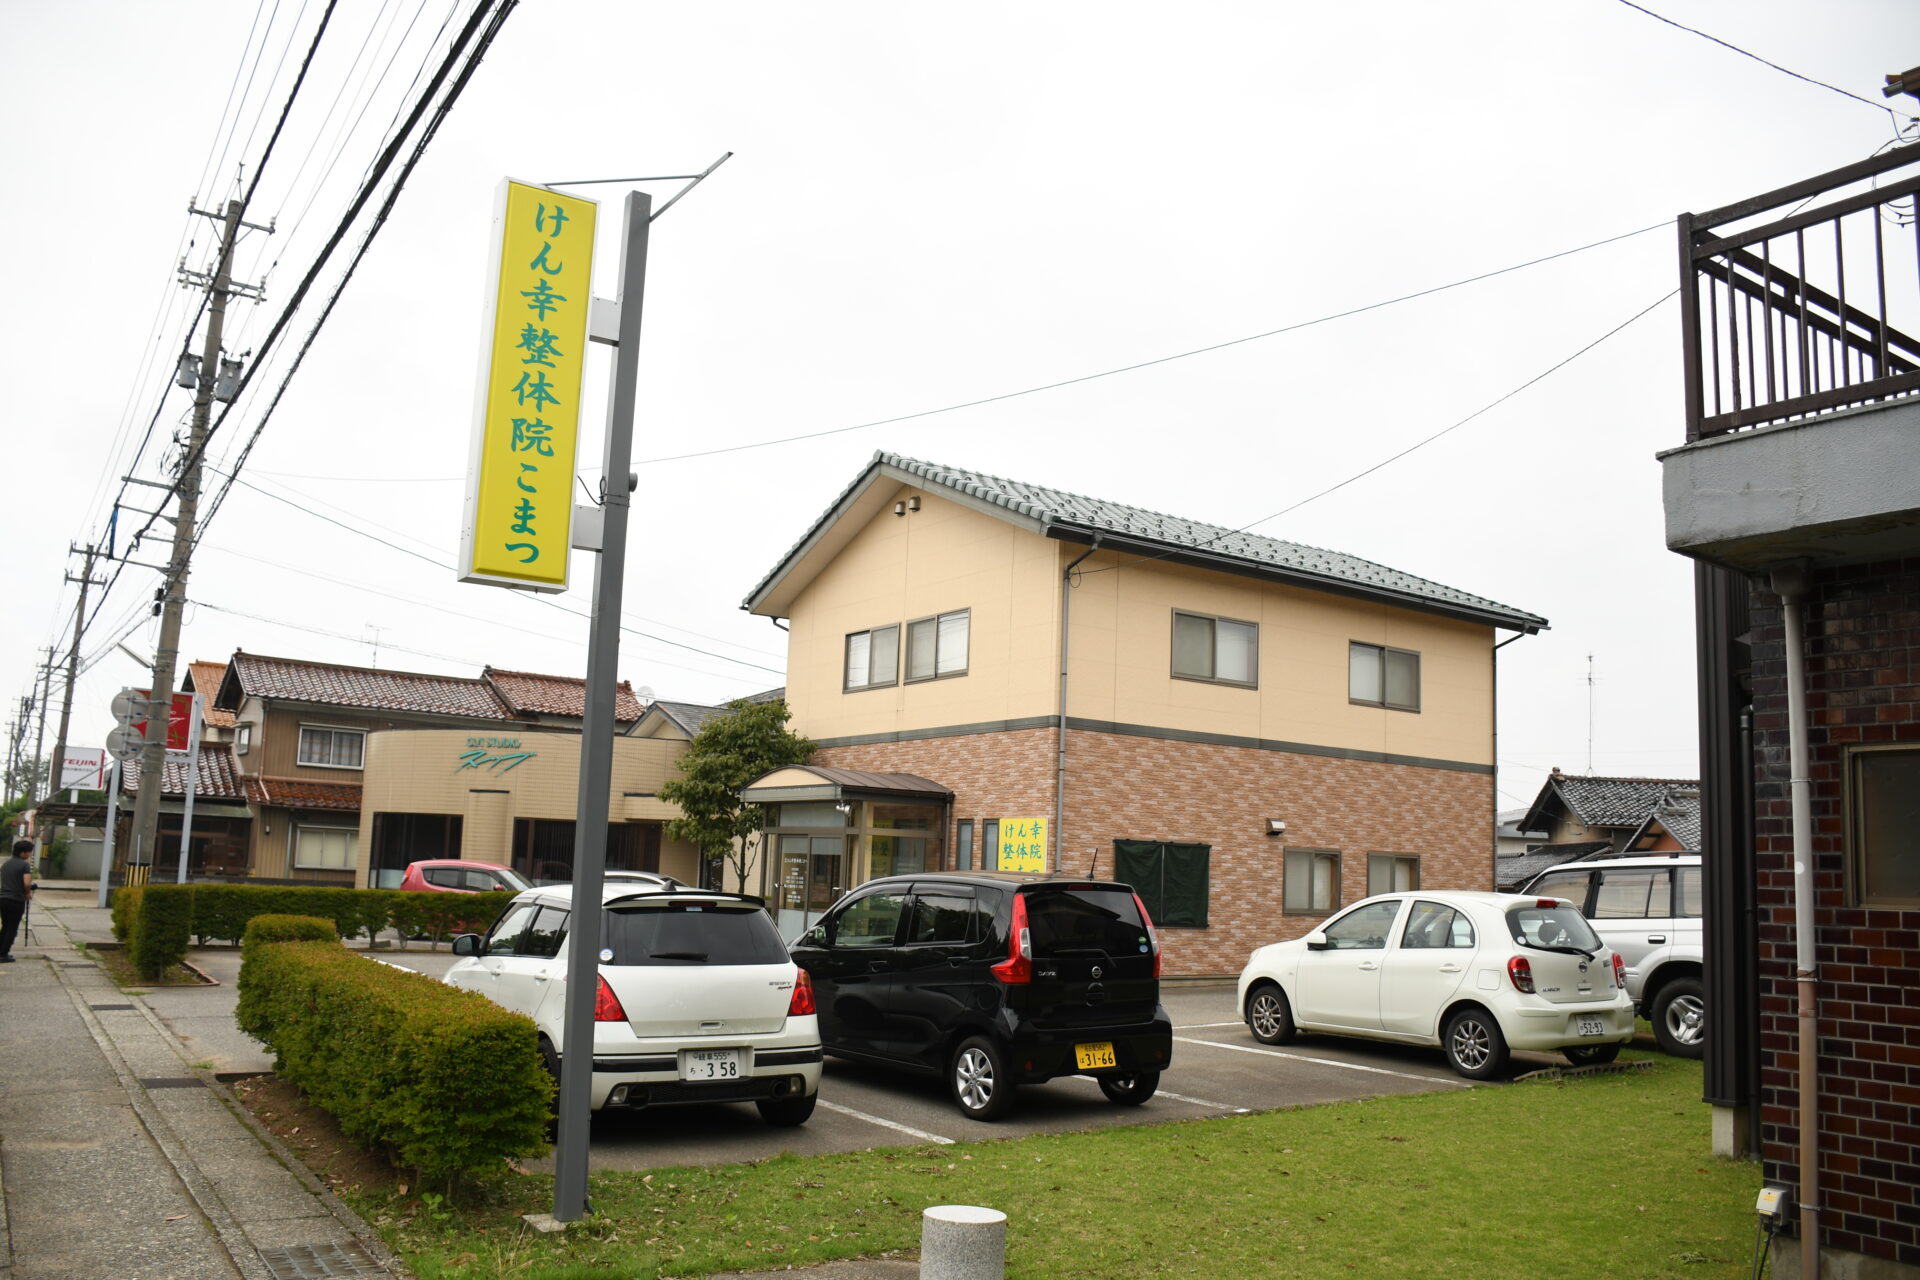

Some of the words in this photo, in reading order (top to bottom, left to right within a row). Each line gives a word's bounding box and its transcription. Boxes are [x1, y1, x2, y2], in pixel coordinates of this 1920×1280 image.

[505, 201, 570, 564] けん幸整体院こまつ
[1005, 820, 1042, 839] けん幸
[1003, 842, 1042, 860] 整体院
